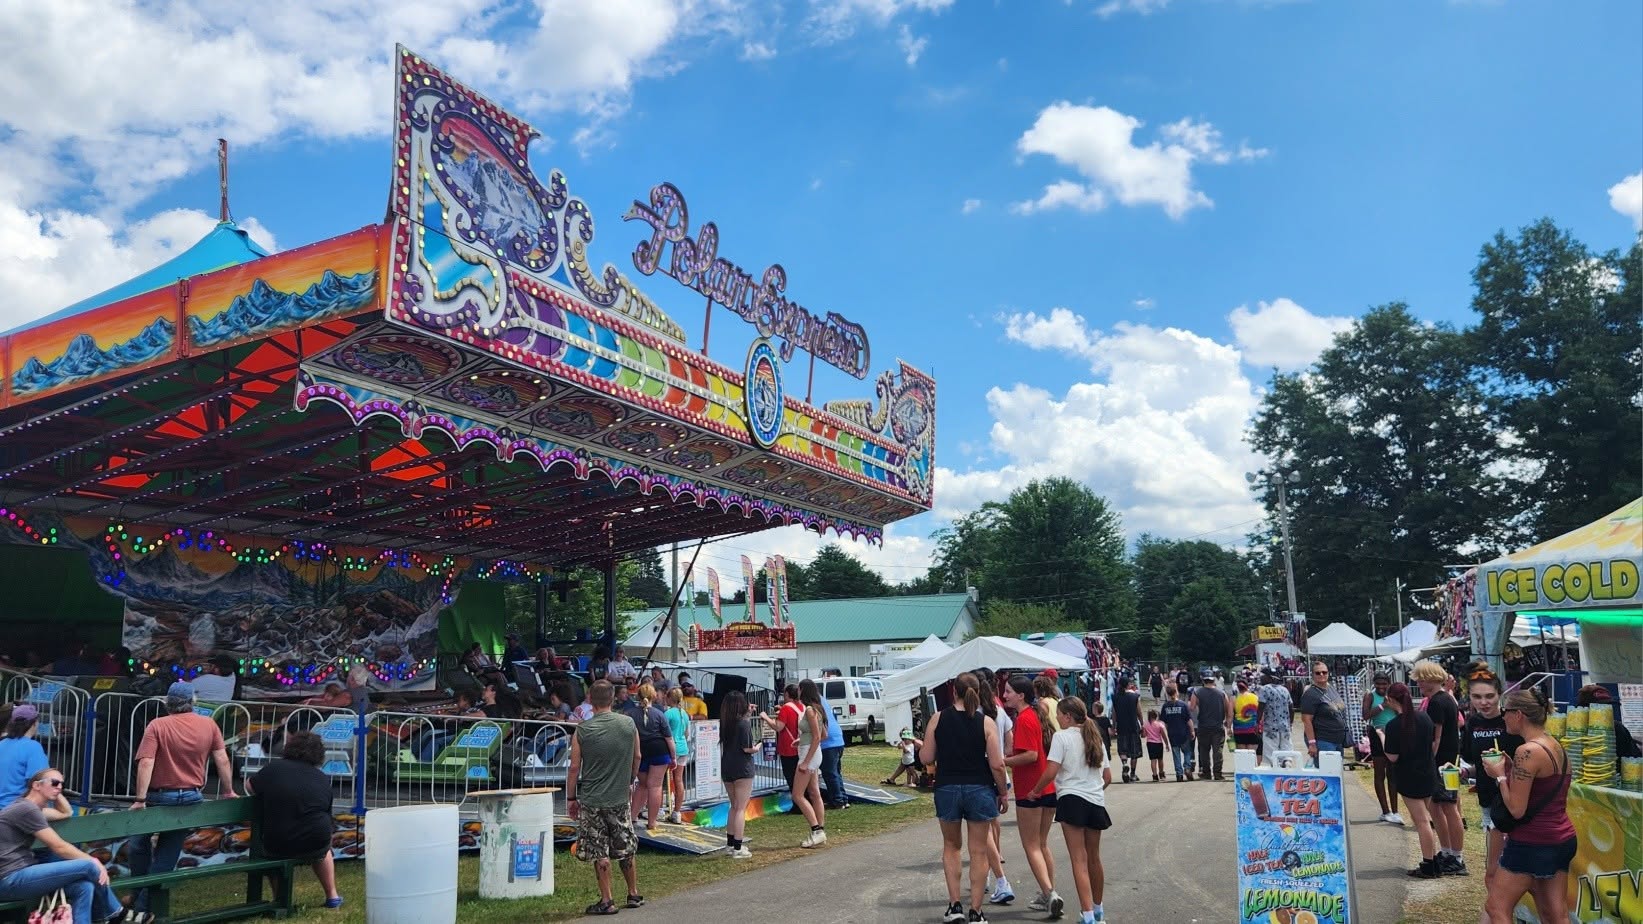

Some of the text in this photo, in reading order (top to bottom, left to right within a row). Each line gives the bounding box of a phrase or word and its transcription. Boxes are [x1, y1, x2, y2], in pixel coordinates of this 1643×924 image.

[1487, 559, 1640, 606] ICE COLD
[1274, 777, 1327, 796] ICED
[1281, 798, 1321, 817] TEA
[1292, 862, 1345, 879] LEMONADE
[1243, 888, 1345, 924] LEMONADE
